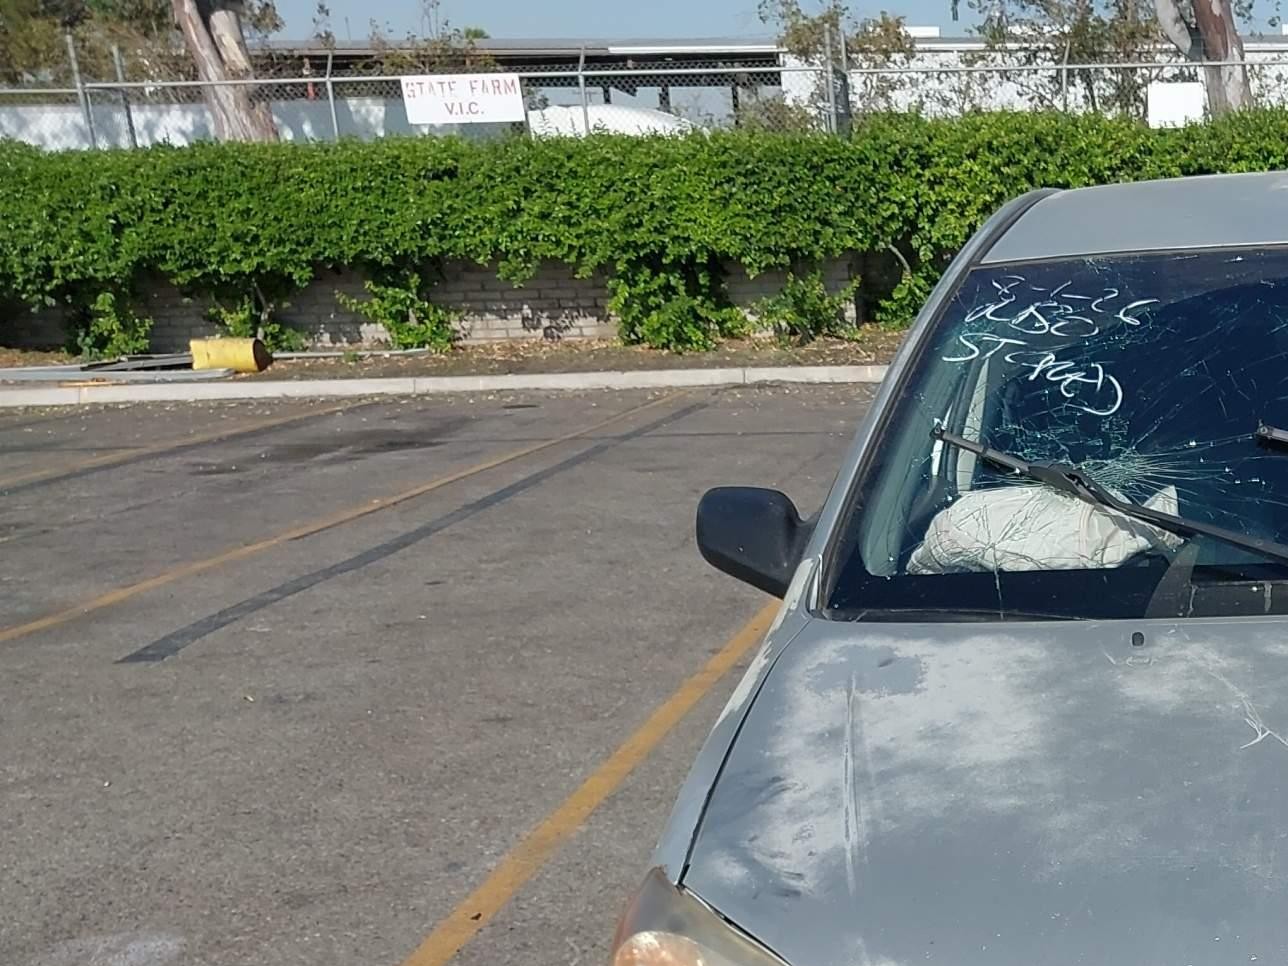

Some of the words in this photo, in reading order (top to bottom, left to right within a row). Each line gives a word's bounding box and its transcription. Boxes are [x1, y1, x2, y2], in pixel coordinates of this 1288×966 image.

[405, 80, 456, 98] STATE
[469, 79, 517, 96] FARM
[444, 101, 484, 116] V.I.C.
